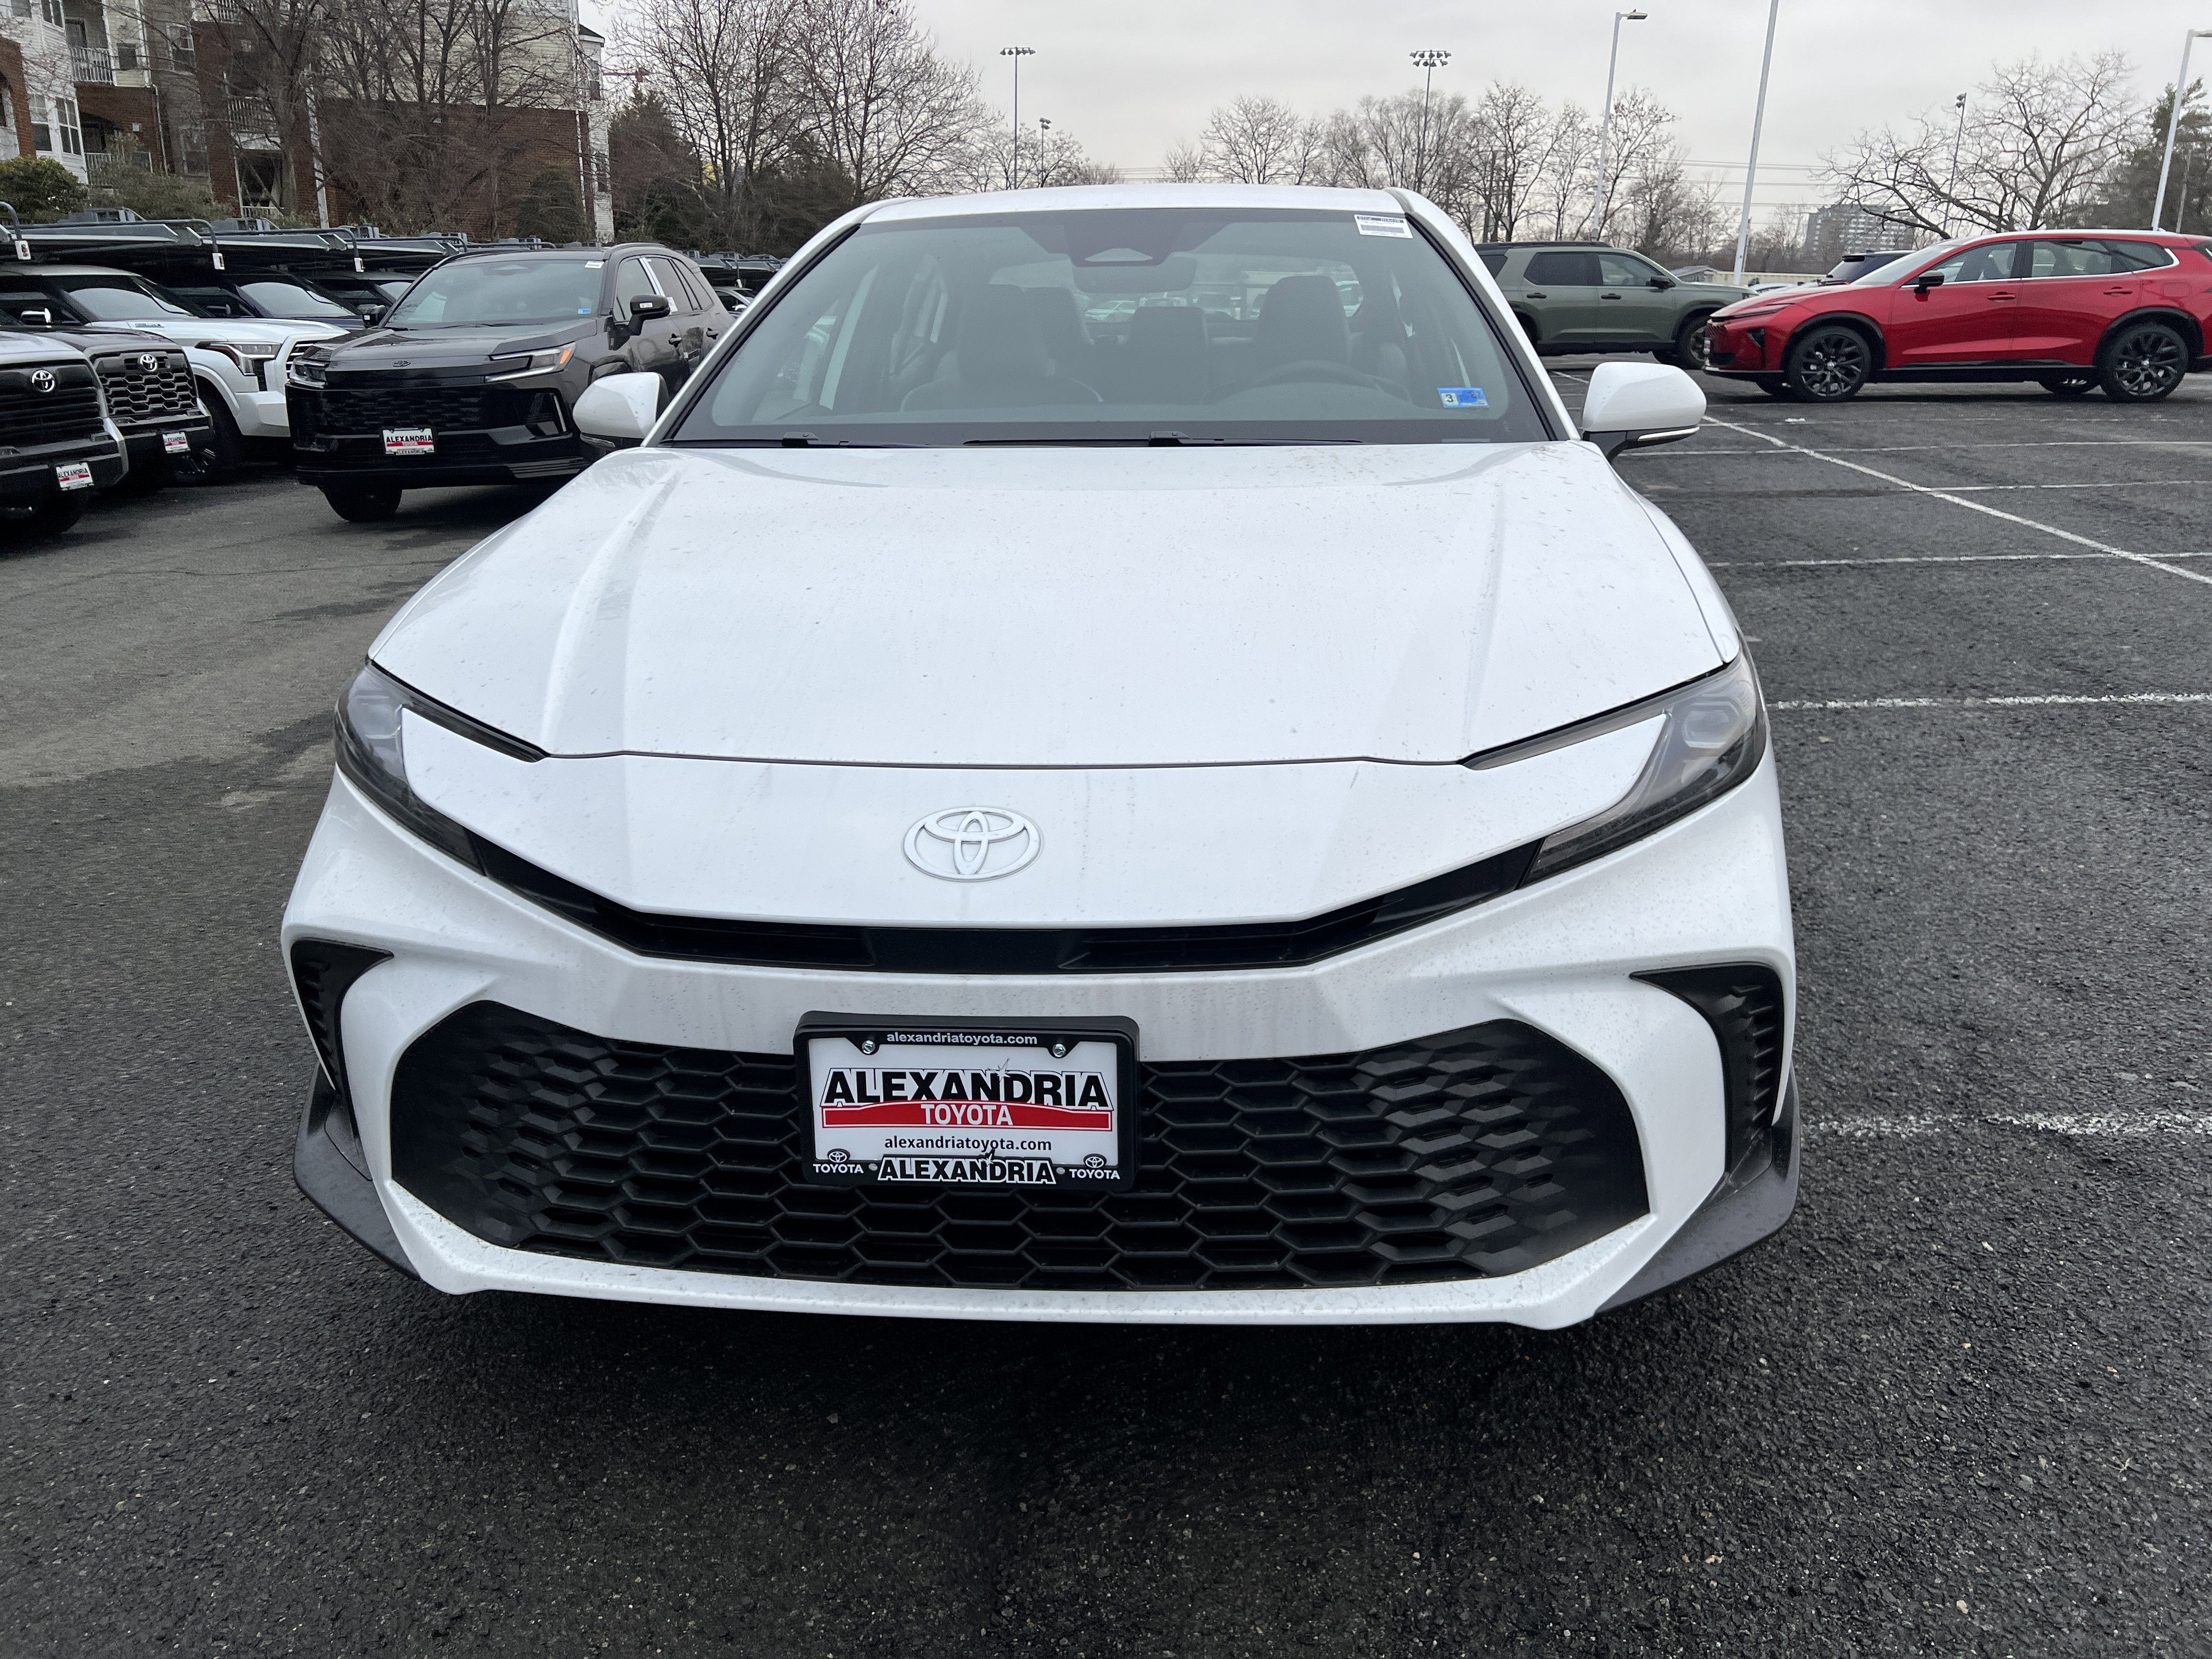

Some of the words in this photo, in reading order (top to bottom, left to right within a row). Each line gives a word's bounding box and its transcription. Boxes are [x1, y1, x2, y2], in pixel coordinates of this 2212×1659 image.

[1445, 394, 1454, 403] 3
[887, 1031, 1037, 1046] alexandriatoyota.com
[823, 1070, 1110, 1108] ALEXANDRIA
[921, 1103, 1013, 1126] TOYOTA
[884, 1135, 1052, 1152] alexandriatoyota.com
[812, 1163, 864, 1174] TOYOTA
[879, 1158, 1055, 1184] ALEXANDRIA
[1069, 1168, 1120, 1180] TOYOTA
